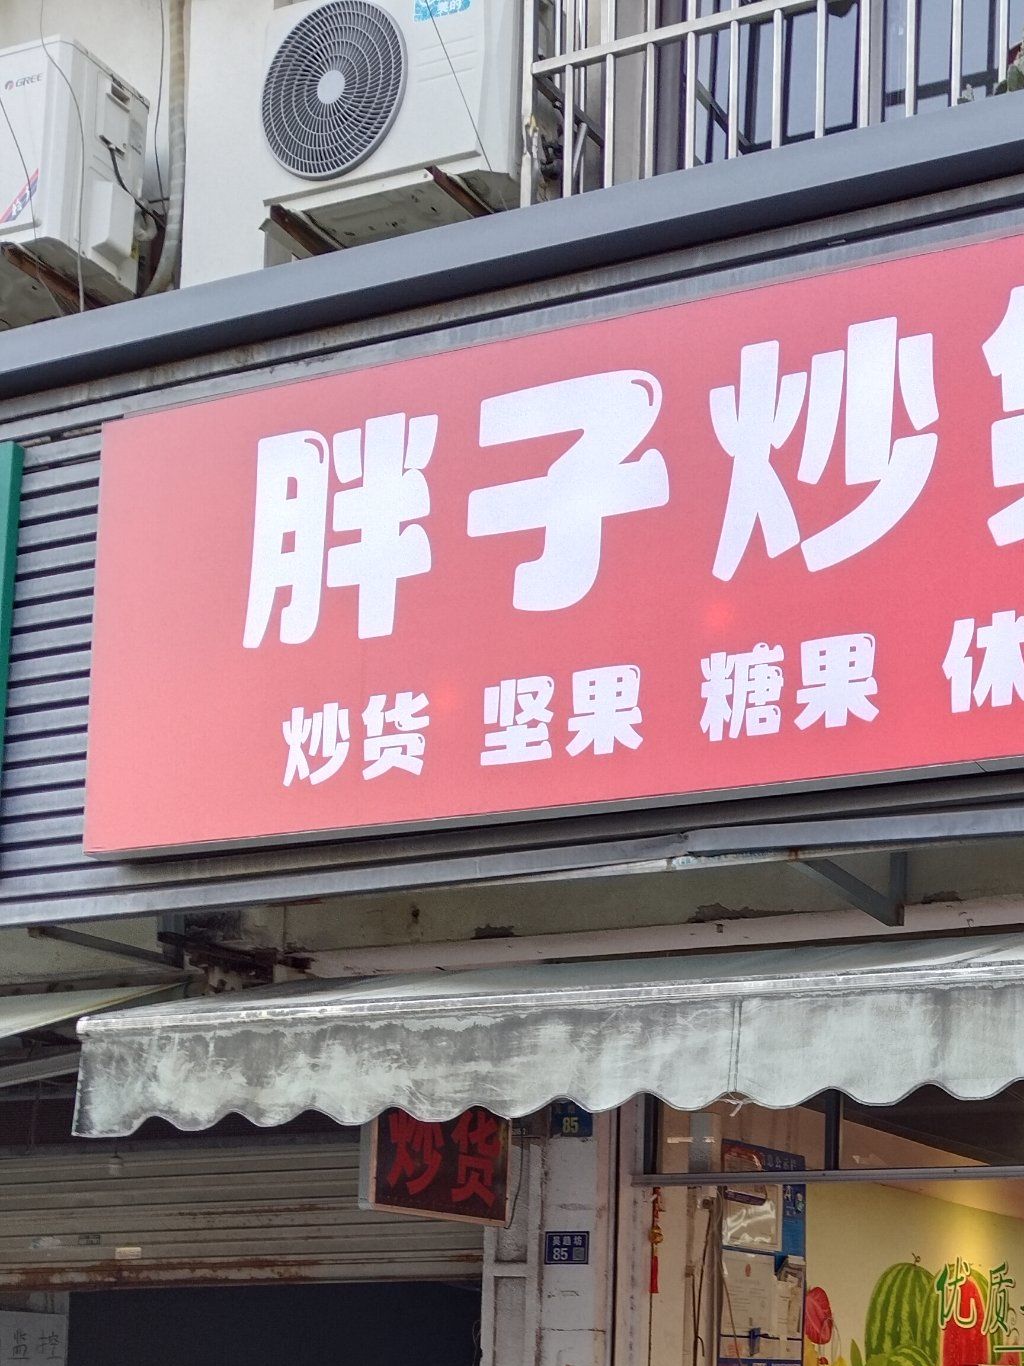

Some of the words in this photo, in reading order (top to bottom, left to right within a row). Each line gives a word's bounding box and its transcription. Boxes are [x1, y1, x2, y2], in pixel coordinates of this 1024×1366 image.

[15, 73, 43, 87] GREE
[282, 691, 430, 787] 炒货
[480, 664, 644, 766] 坚果
[700, 632, 880, 742] 糖果
[562, 1116, 580, 1133] 85
[387, 1107, 502, 1209] 炒货
[552, 1247, 569, 1260] 85
